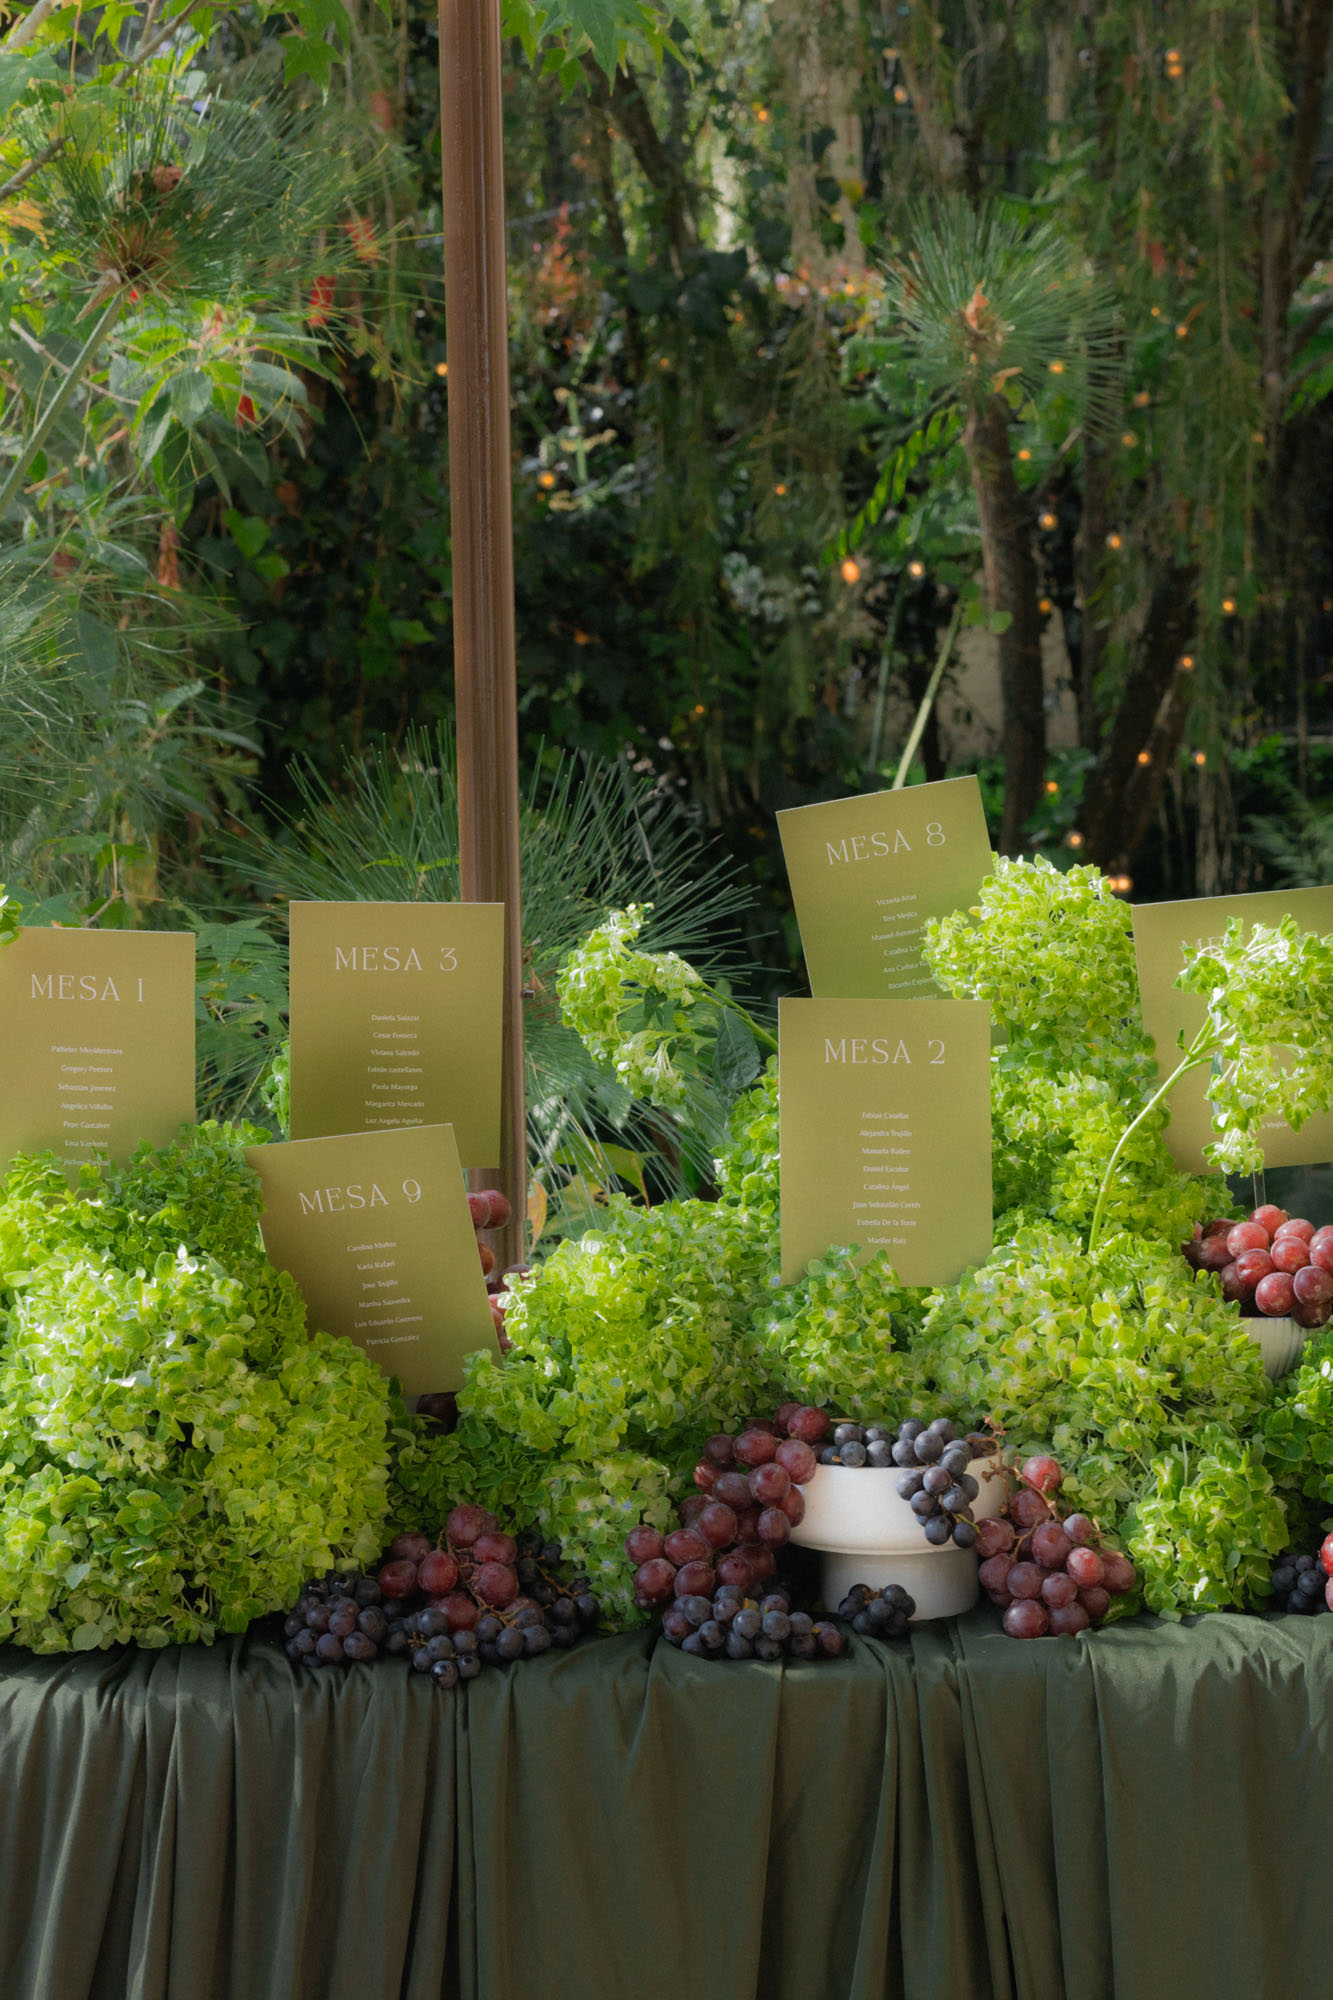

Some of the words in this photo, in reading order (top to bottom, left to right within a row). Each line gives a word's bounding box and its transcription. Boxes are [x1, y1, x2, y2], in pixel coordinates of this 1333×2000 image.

[826, 829, 912, 865] MESA
[926, 822, 945, 847] 8
[335, 946, 424, 971] MESA
[439, 947, 458, 972] 3
[31, 974, 120, 1001] MESA
[137, 977, 144, 1002] 1
[824, 1038, 912, 1064] MESA
[928, 1039, 946, 1064] 2
[298, 1183, 389, 1215] MESA
[402, 1178, 421, 1203] 9
